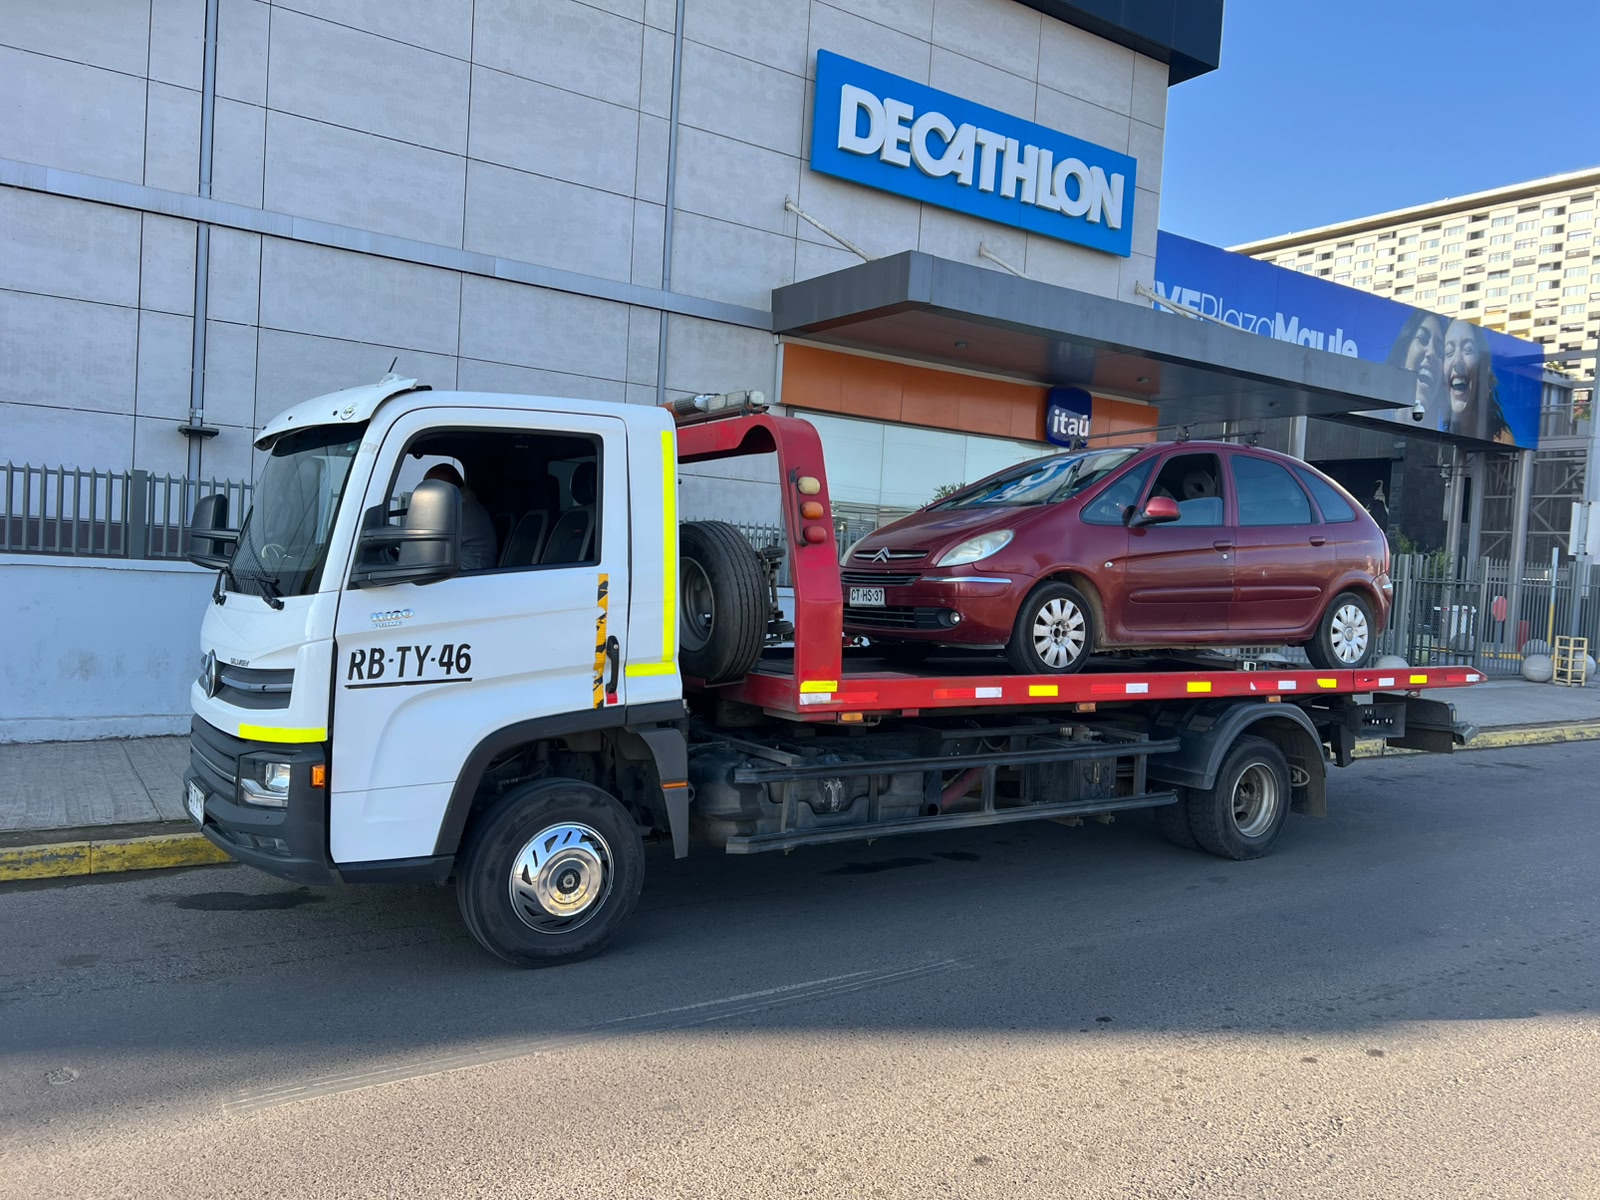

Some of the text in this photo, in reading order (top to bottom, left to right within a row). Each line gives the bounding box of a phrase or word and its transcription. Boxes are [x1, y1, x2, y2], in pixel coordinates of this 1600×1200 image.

[838, 84, 1125, 230] DECATHLON
[1053, 409, 1090, 437] itaú
[851, 588, 860, 601] CT
